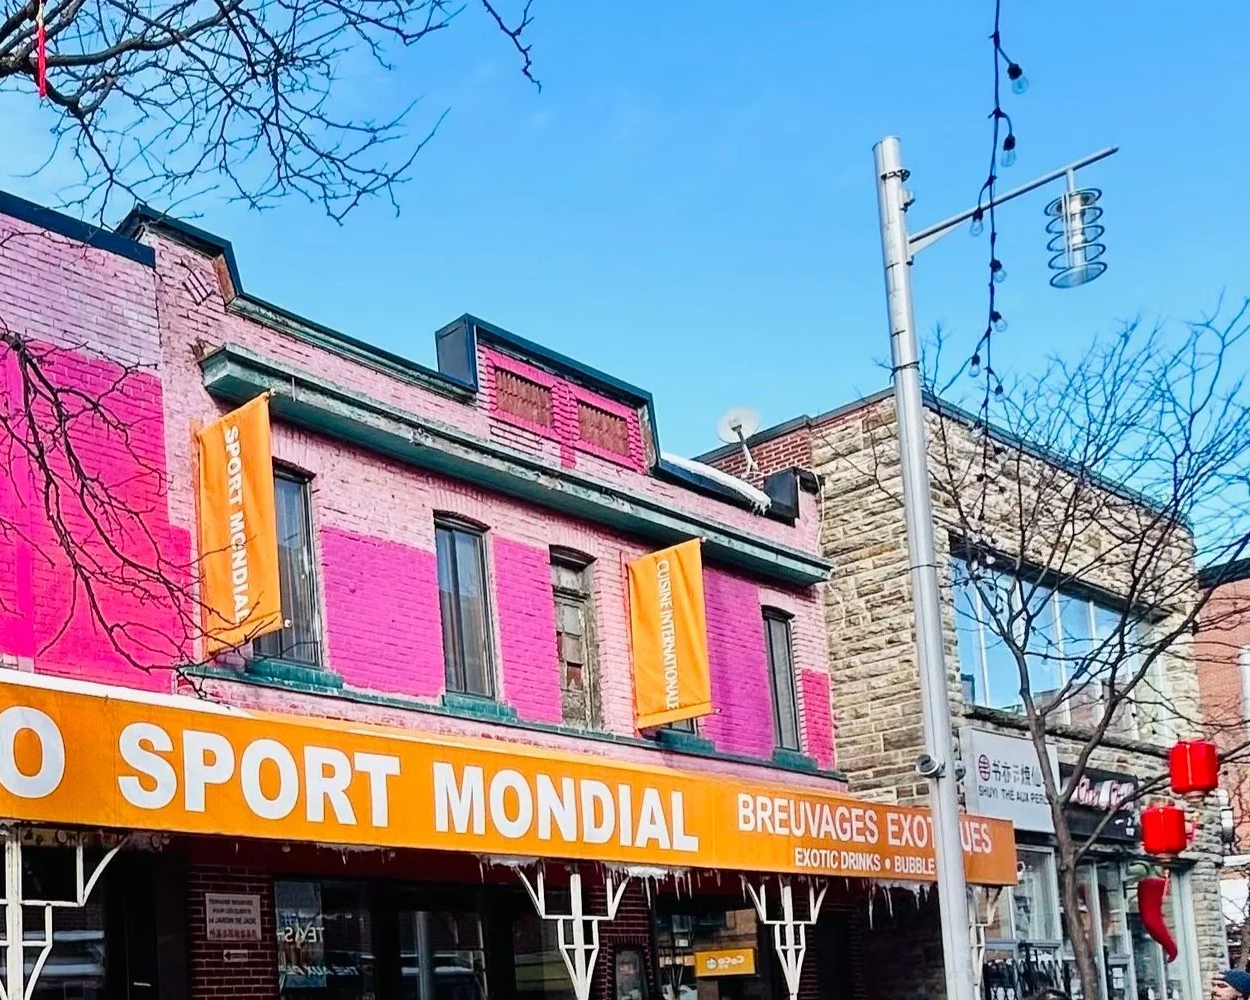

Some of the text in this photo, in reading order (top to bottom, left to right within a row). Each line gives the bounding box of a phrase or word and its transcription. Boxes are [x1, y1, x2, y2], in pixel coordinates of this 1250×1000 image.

[224, 425, 250, 624] SPORT MONDIAL
[657, 559, 672, 610] CUISINE
[118, 722, 401, 828] SPORT
[433, 762, 699, 852] MONDIAL
[737, 792, 879, 845] BREUVAGES
[794, 846, 935, 876] EXOTIC DRINKS BUBBLE
